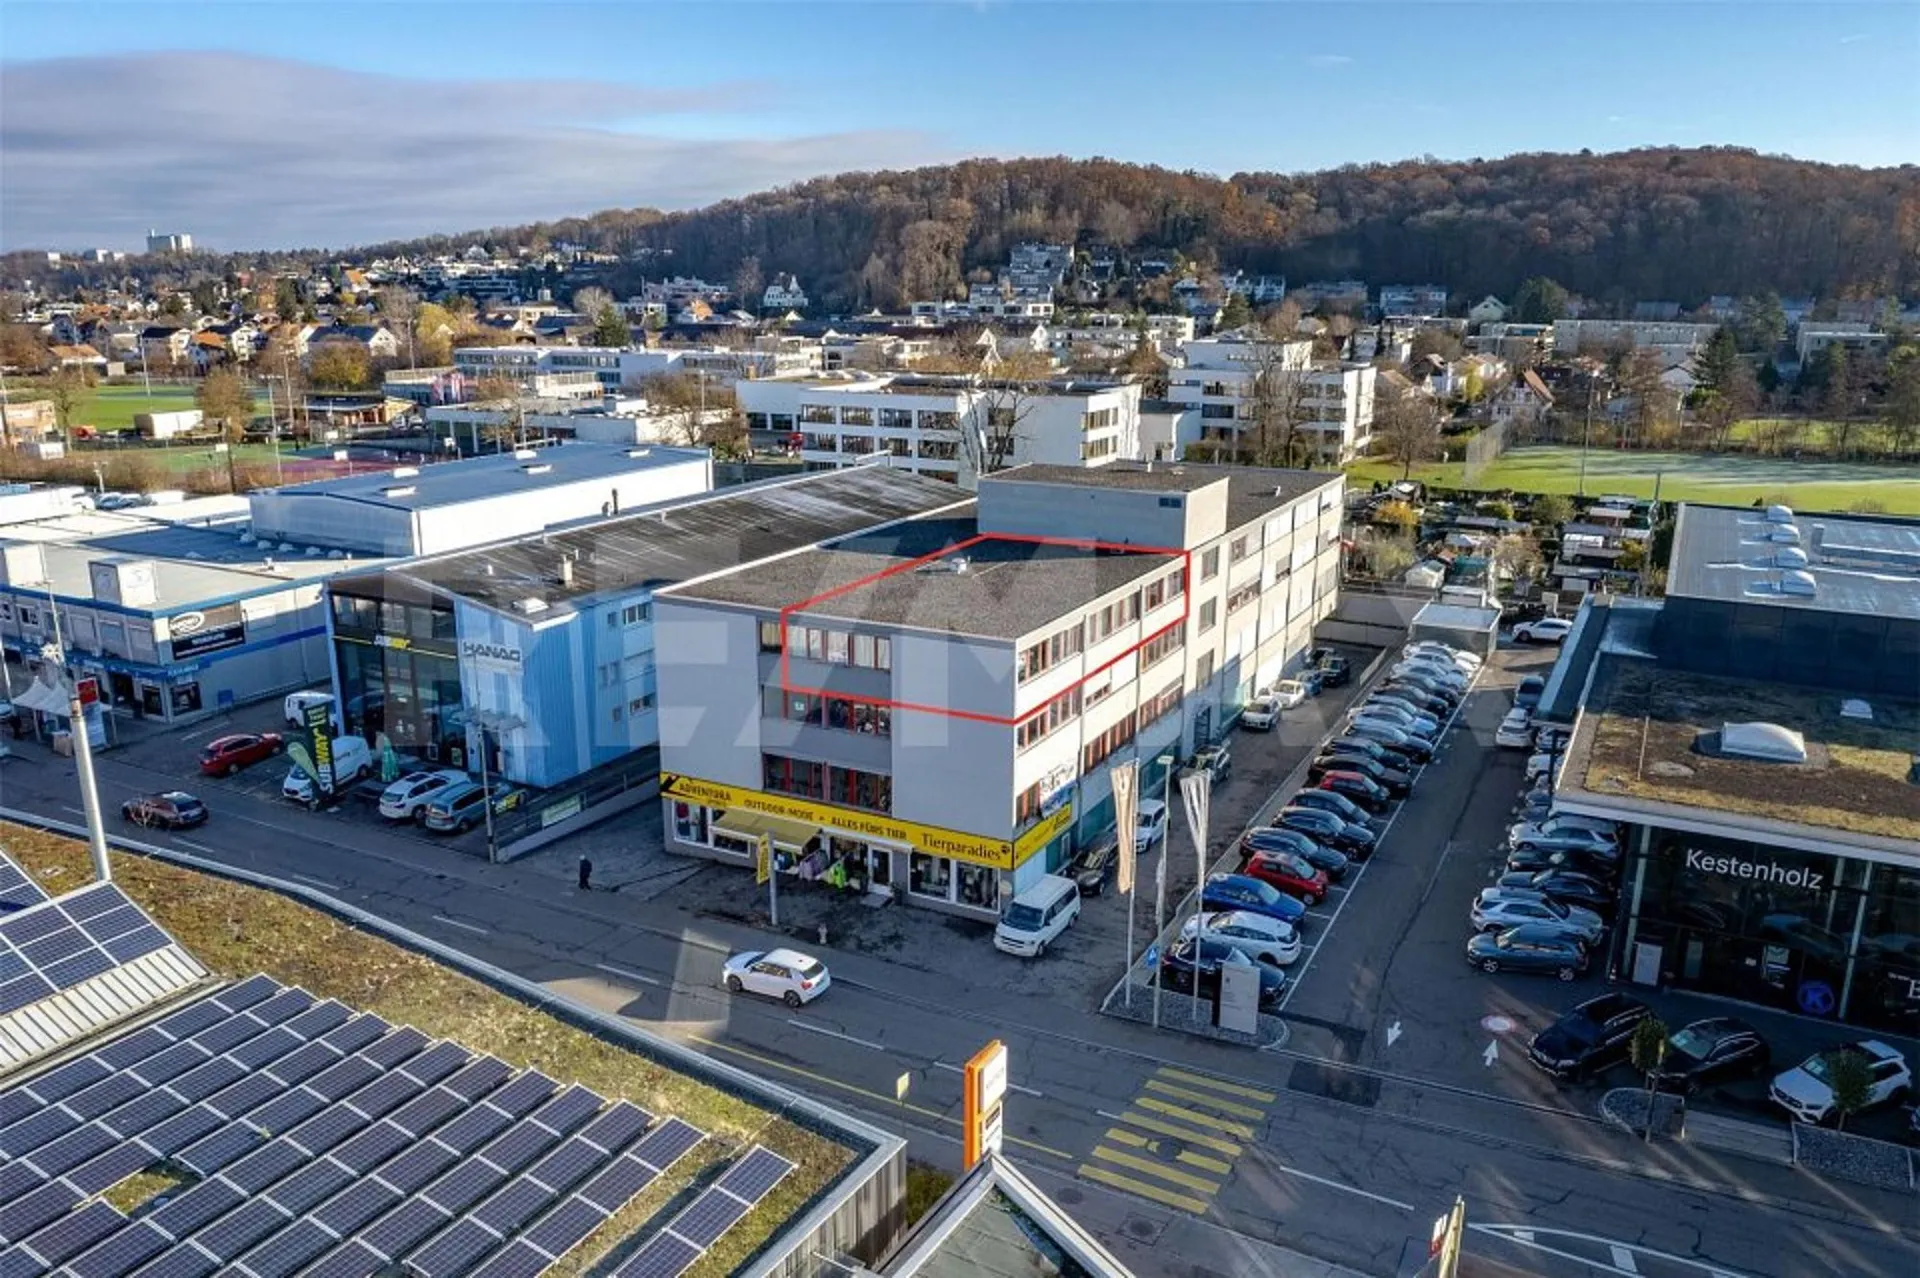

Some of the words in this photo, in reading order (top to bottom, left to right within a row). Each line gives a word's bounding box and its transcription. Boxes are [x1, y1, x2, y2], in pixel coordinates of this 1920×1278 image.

[313, 727, 334, 795] SUBWAY
[886, 826, 908, 841] TIER
[921, 832, 1001, 860] Tierparadies
[1685, 848, 1825, 890] Kestenholz
